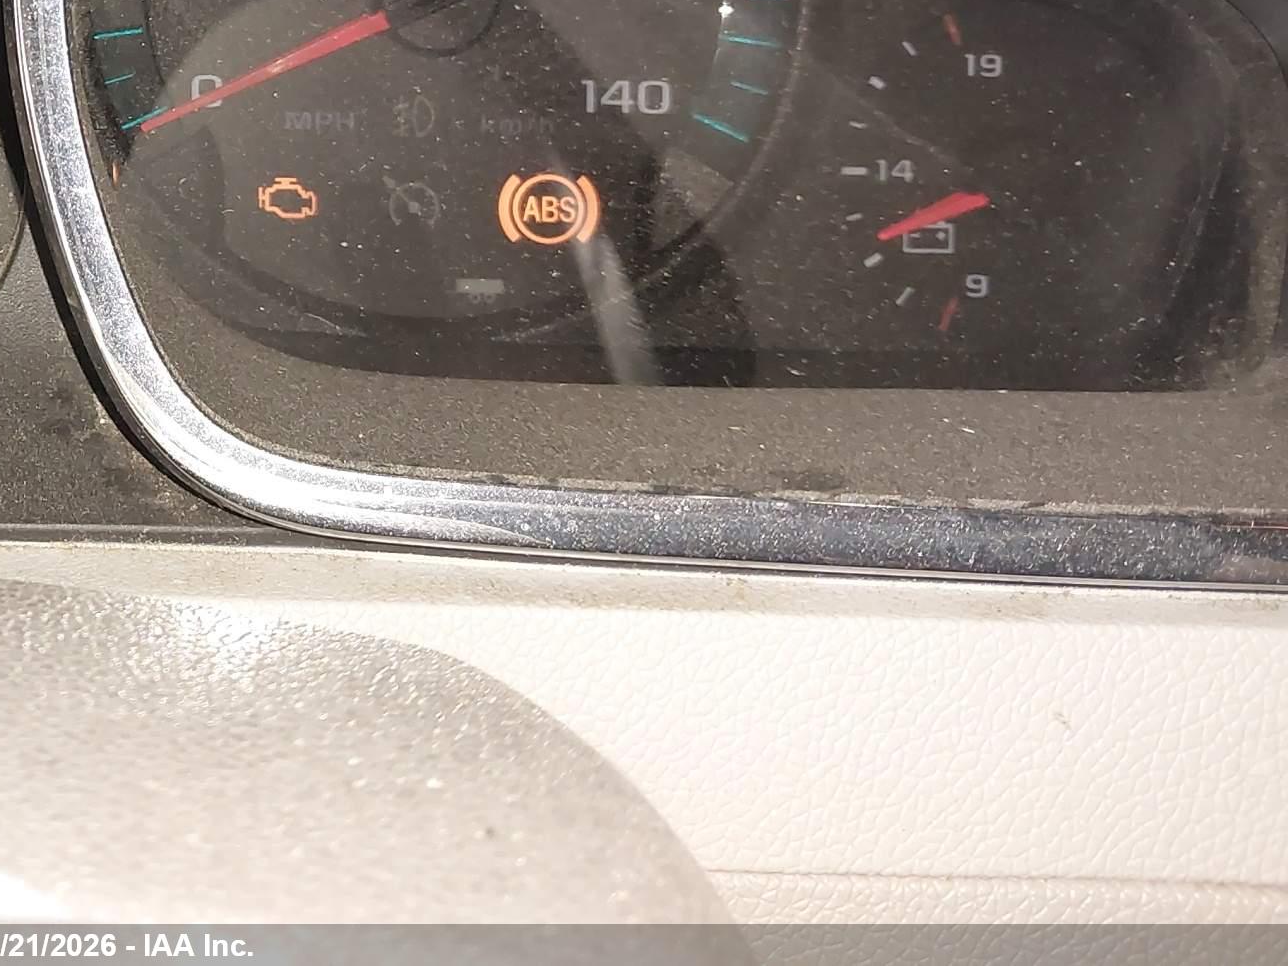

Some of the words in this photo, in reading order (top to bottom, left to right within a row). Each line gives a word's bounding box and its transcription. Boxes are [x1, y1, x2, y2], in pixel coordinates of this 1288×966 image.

[964, 52, 1003, 78] 19
[189, 74, 224, 108] 0
[582, 79, 672, 115] 140
[284, 110, 357, 132] MPH
[875, 159, 913, 183] 14
[521, 194, 580, 225] ABS
[965, 274, 990, 299] 9
